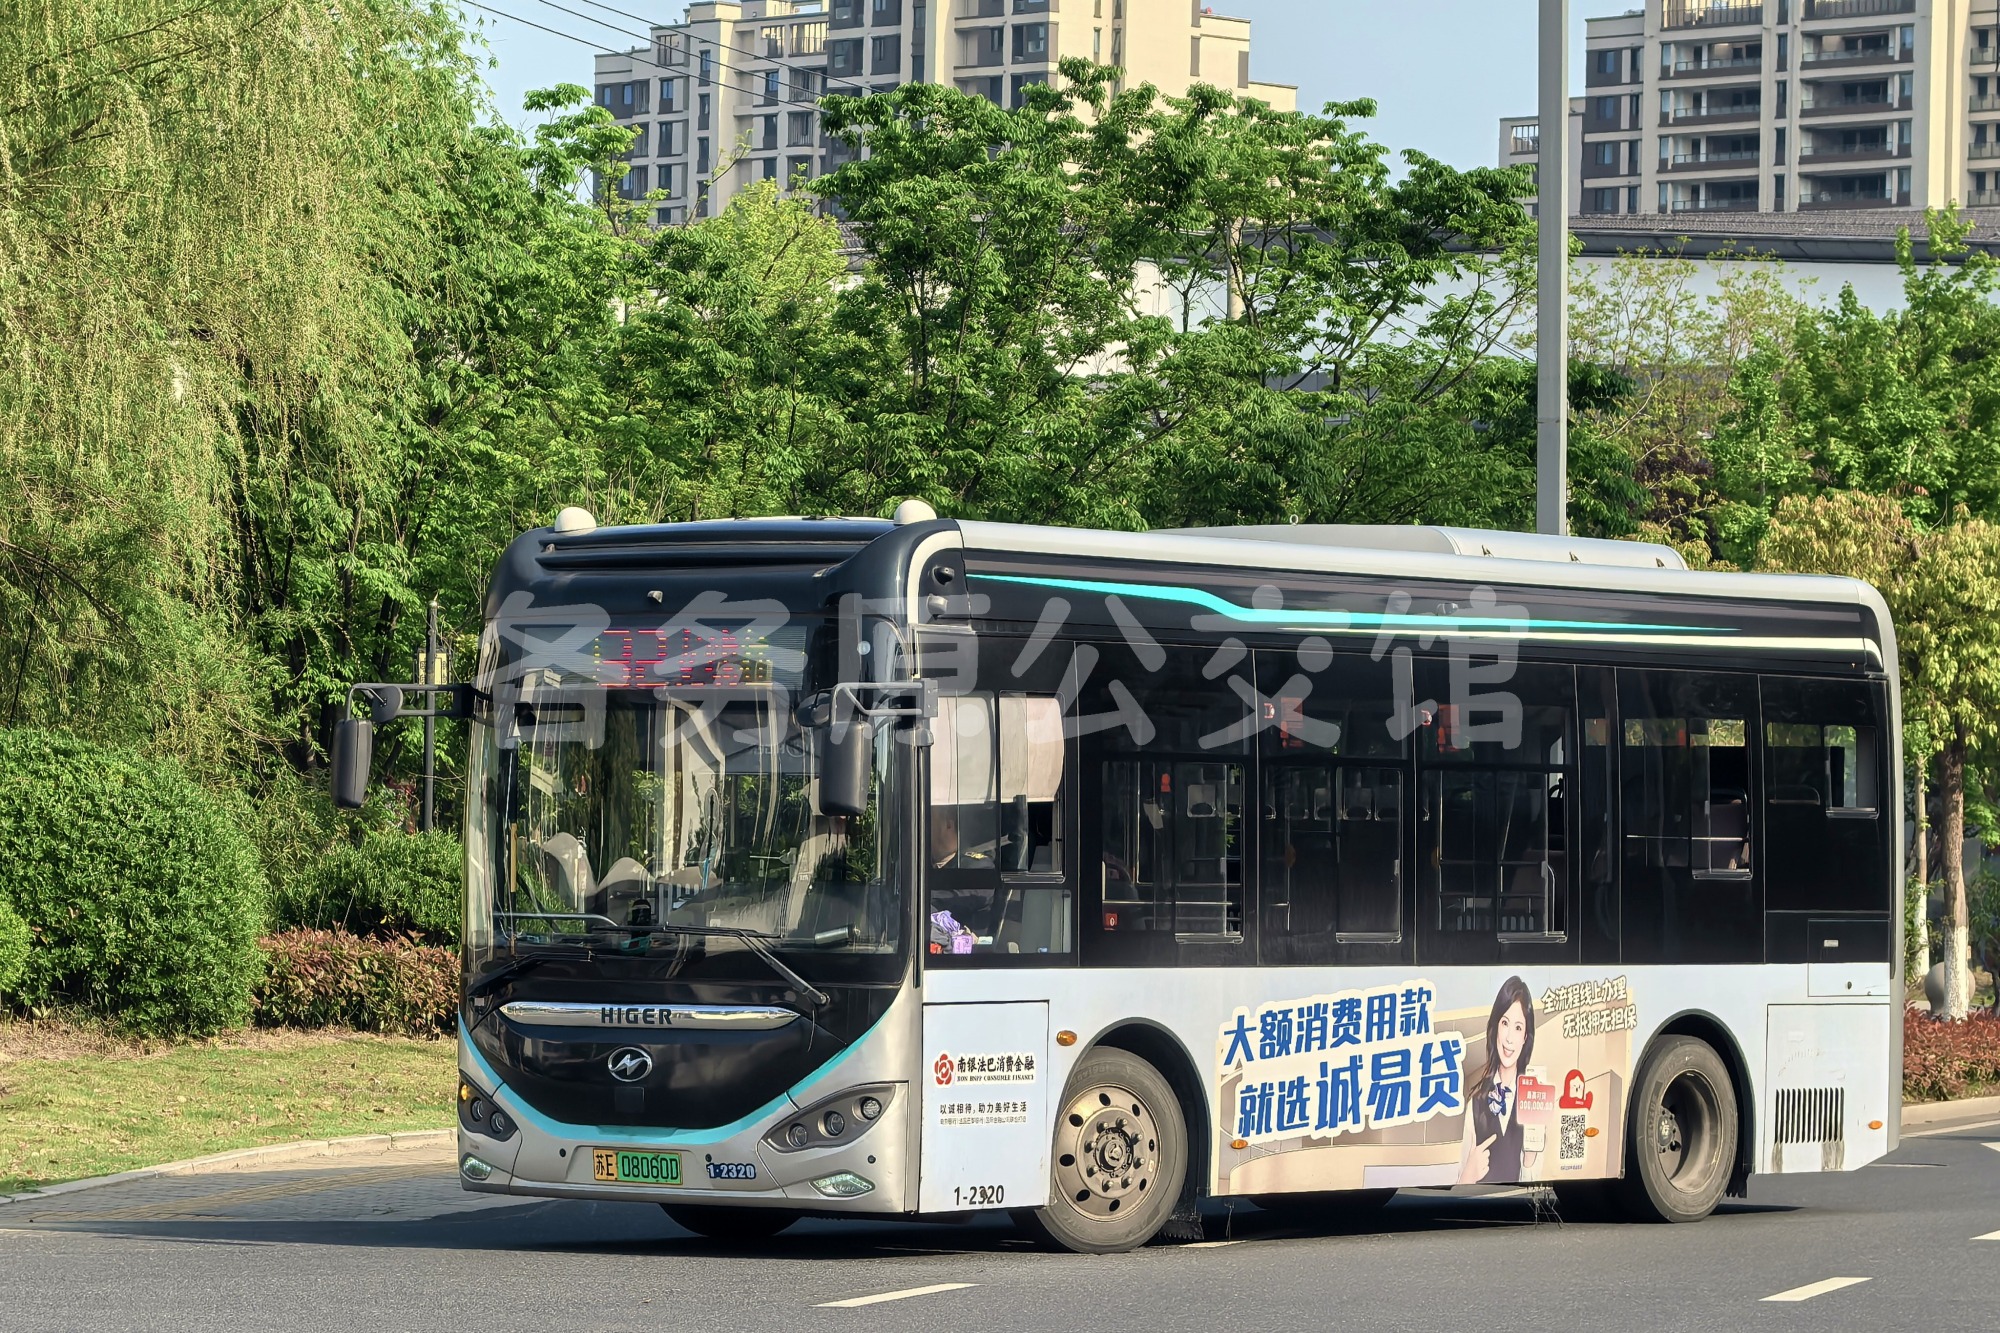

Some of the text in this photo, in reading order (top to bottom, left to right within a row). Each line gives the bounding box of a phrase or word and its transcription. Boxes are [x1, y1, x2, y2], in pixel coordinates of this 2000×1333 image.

[1541, 975, 1627, 1014] 全流程线上办理
[601, 1007, 672, 1025] HIGER
[1223, 987, 1432, 1066] 大额消费用款
[1563, 1003, 1638, 1038] 无抵押无担保
[957, 1055, 1035, 1073] 南银法巴消费金融
[1238, 1039, 1462, 1138] 就选诚易贷
[621, 1155, 679, 1180] 08060D
